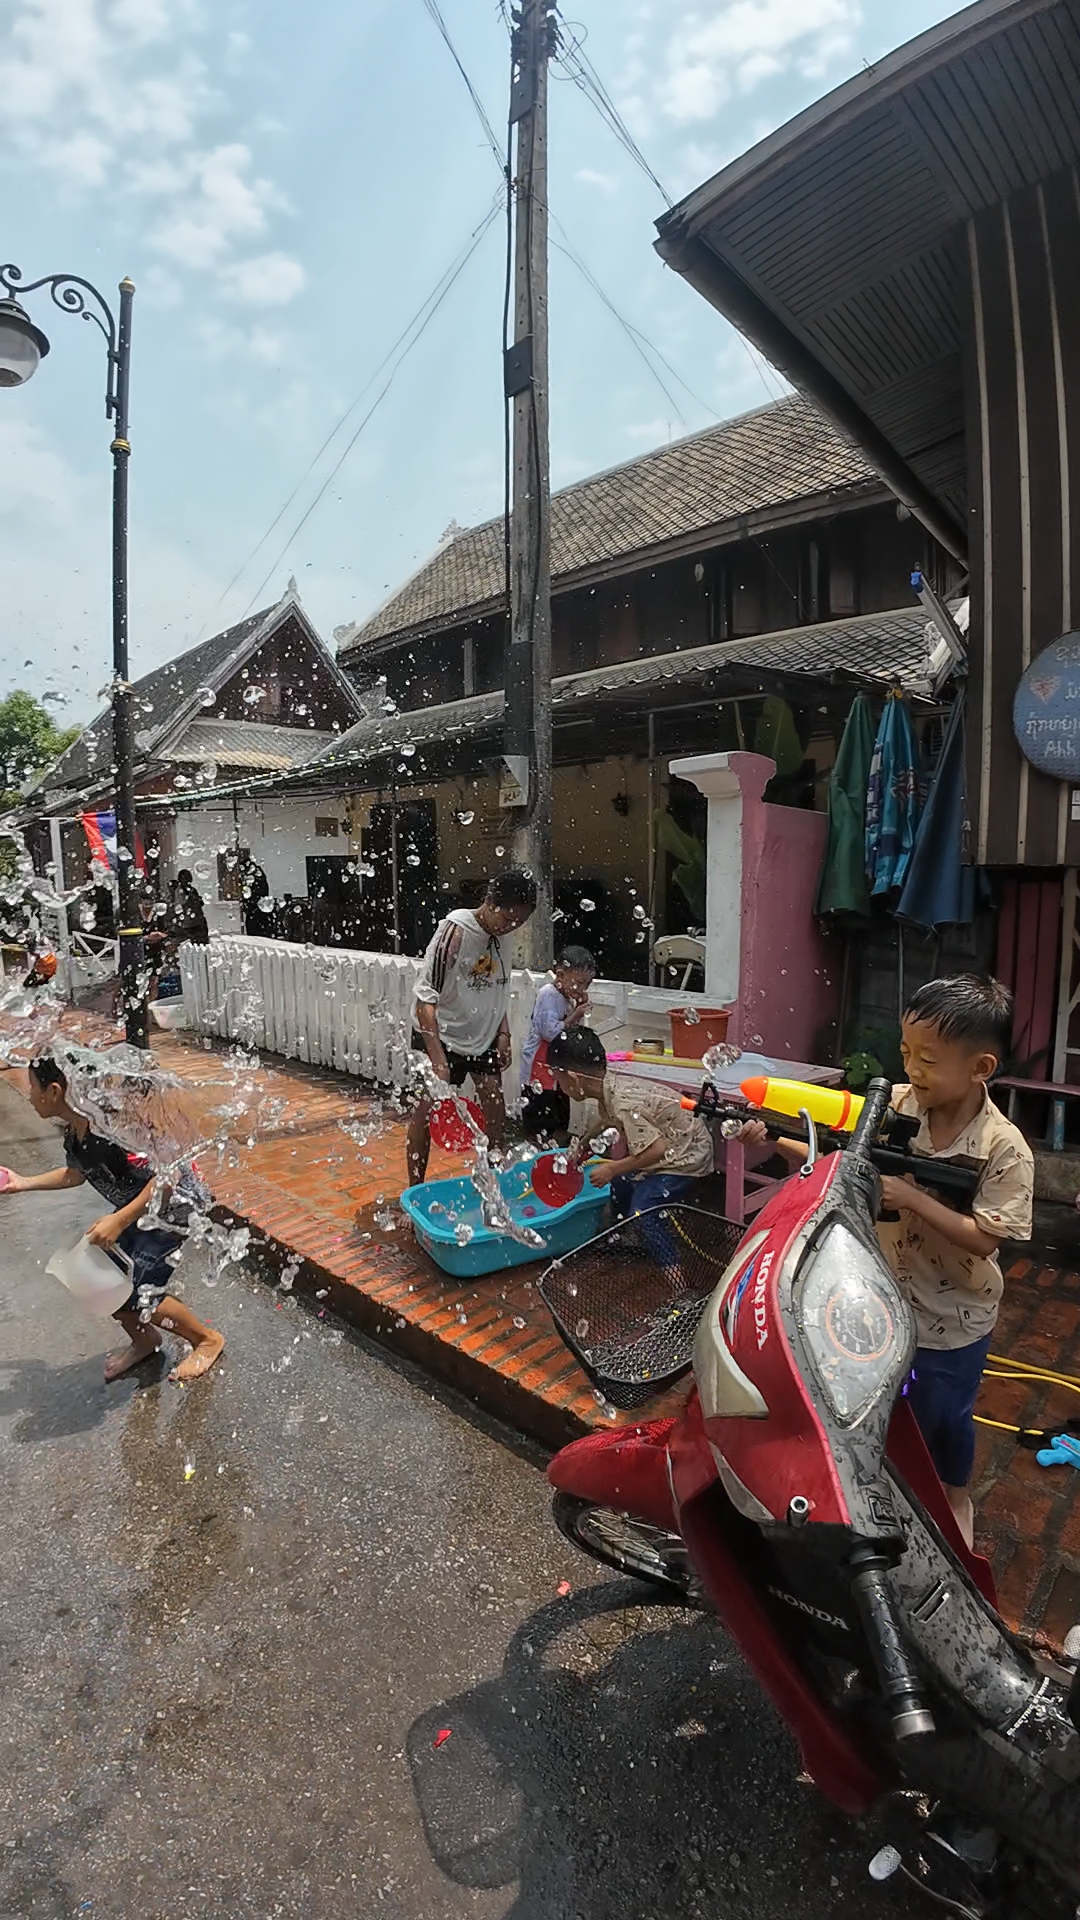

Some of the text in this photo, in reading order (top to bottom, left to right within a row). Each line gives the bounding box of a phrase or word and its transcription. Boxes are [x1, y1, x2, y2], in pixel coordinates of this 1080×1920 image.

[751, 1249, 776, 1351] HONDA
[767, 1585, 849, 1631] HONDA
[1006, 1703, 1034, 1736] ELECTRIC
